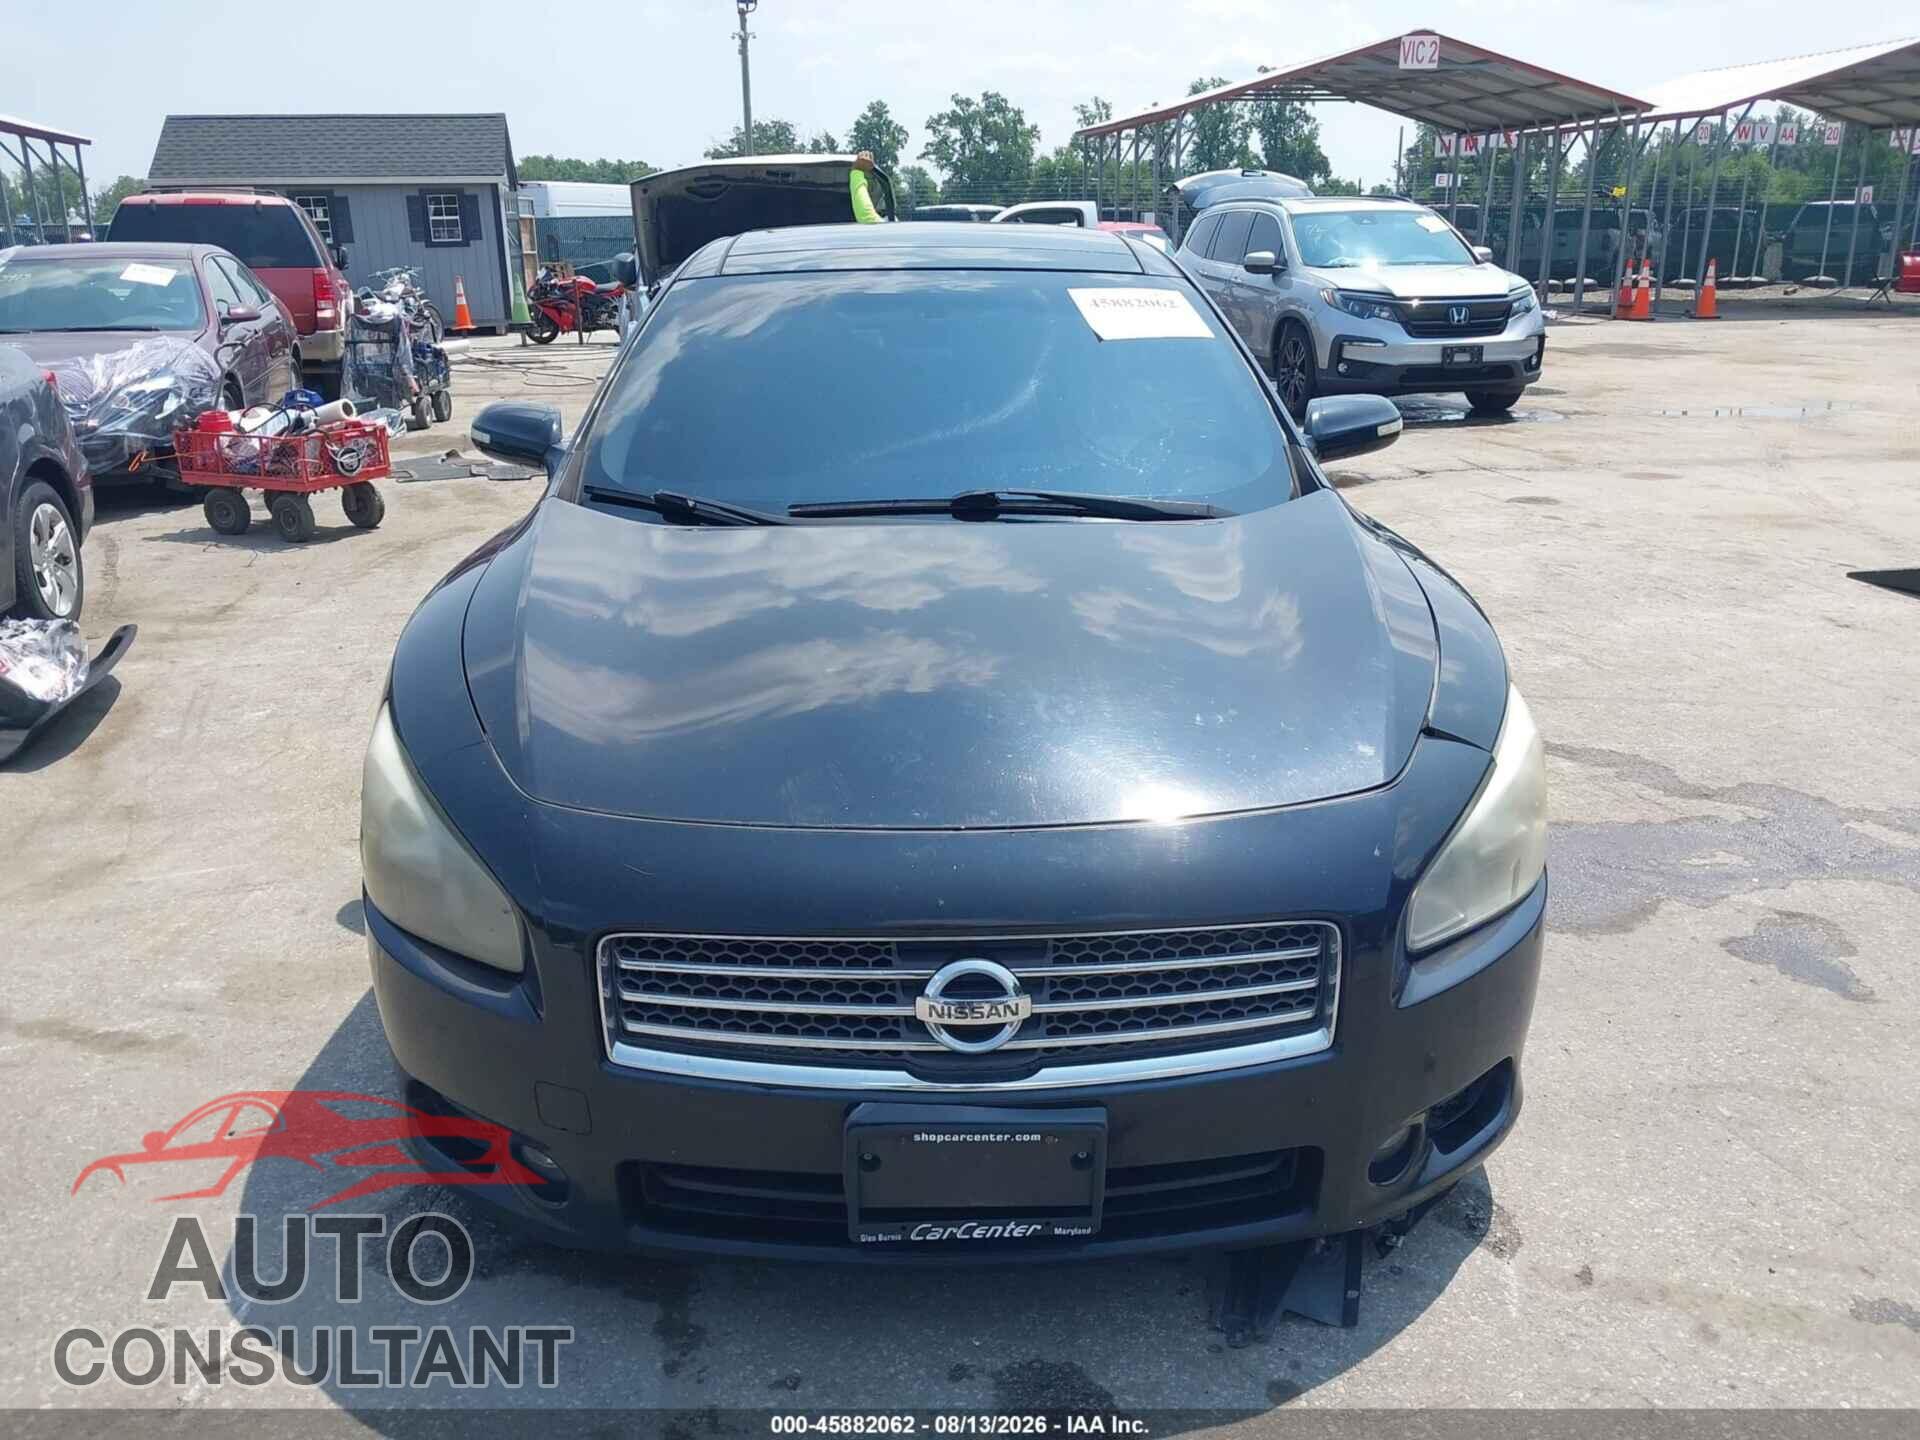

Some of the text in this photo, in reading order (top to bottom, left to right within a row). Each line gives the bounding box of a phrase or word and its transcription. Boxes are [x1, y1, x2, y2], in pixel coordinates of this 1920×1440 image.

[1402, 40, 1438, 65] VIC 2
[1737, 125, 1751, 140] W
[1759, 126, 1769, 139] V
[1781, 128, 1794, 140] AA
[1826, 127, 1839, 141] 20
[928, 1003, 1019, 1020] NISSAN
[913, 1132, 1041, 1143] shopcarcenter.com
[910, 1221, 1042, 1241] CarCenter
[1054, 1225, 1092, 1236] Maryland
